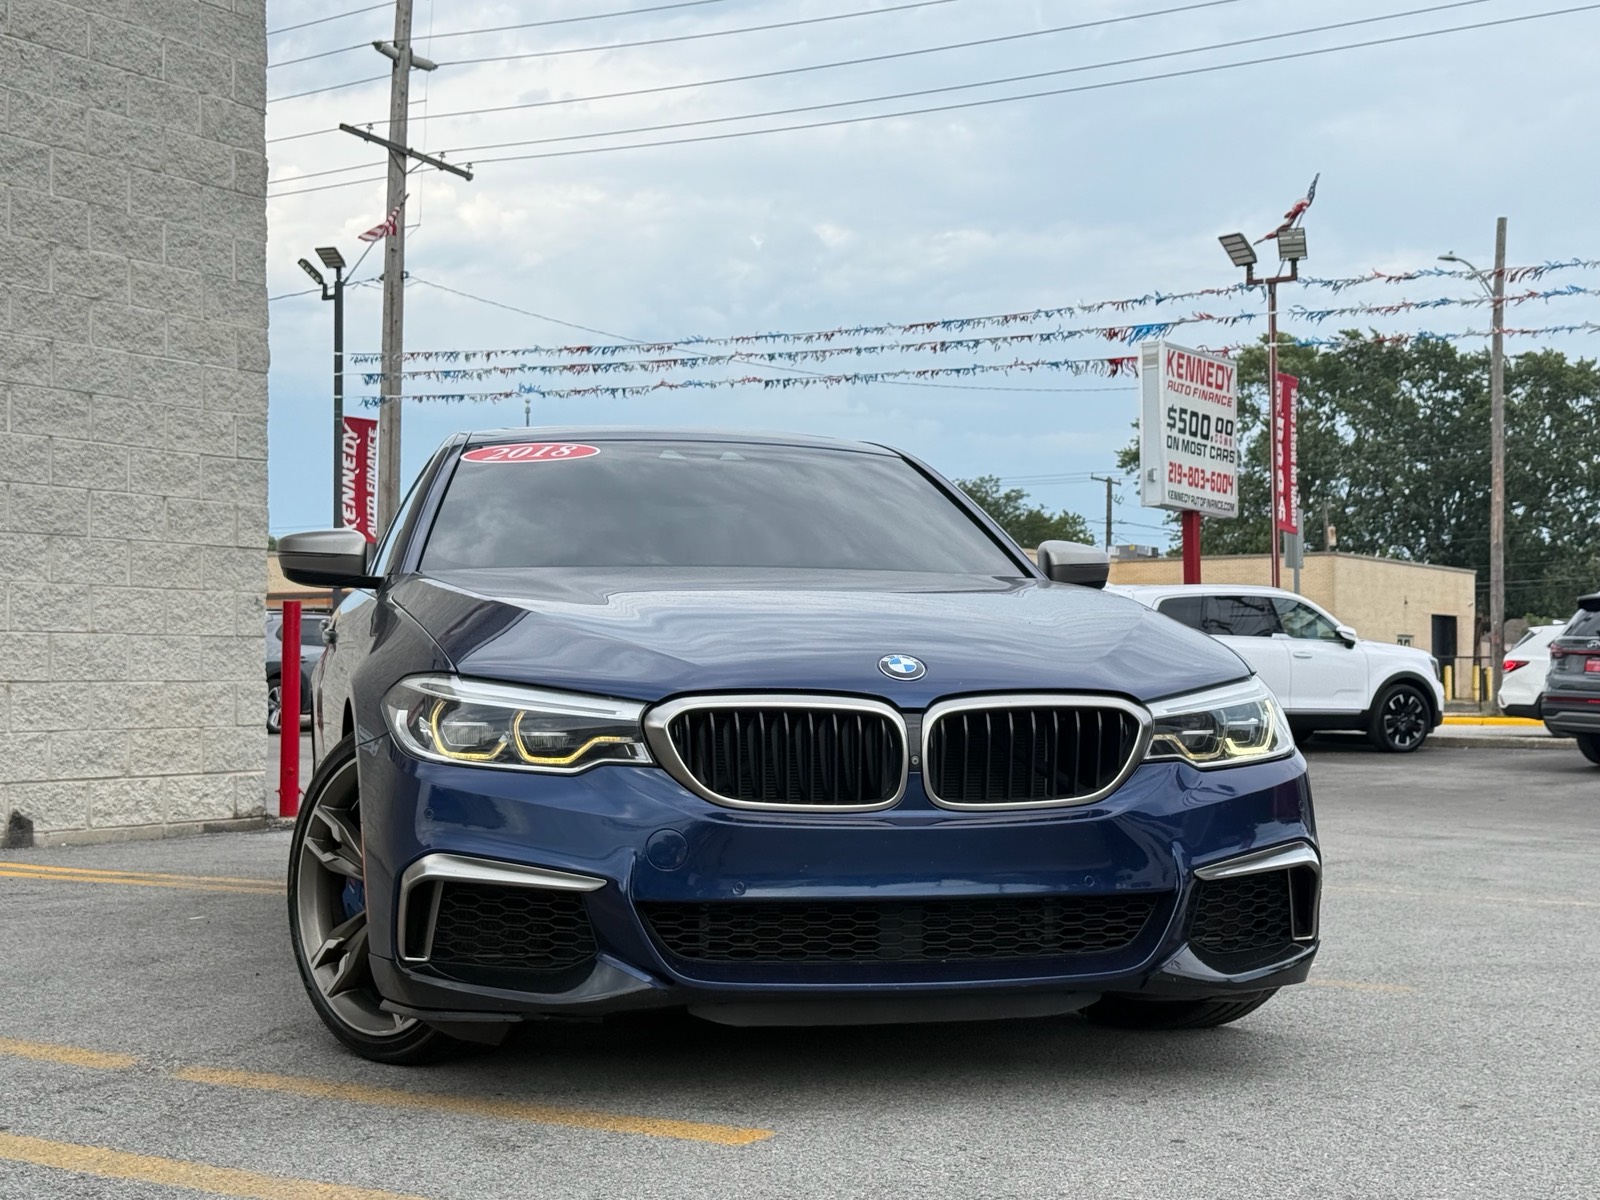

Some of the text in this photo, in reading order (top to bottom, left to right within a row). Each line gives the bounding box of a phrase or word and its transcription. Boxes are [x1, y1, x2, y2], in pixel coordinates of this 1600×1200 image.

[1166, 349, 1234, 393] KENNEDY
[1167, 380, 1233, 408] AUTO FINANCE
[482, 445, 579, 461] 2018
[1166, 435, 1235, 464] ON MOST CARS
[342, 423, 360, 531] KENNEDY
[366, 427, 377, 538] AUTO FINANCE
[1168, 461, 1234, 496] 219-803-6004
